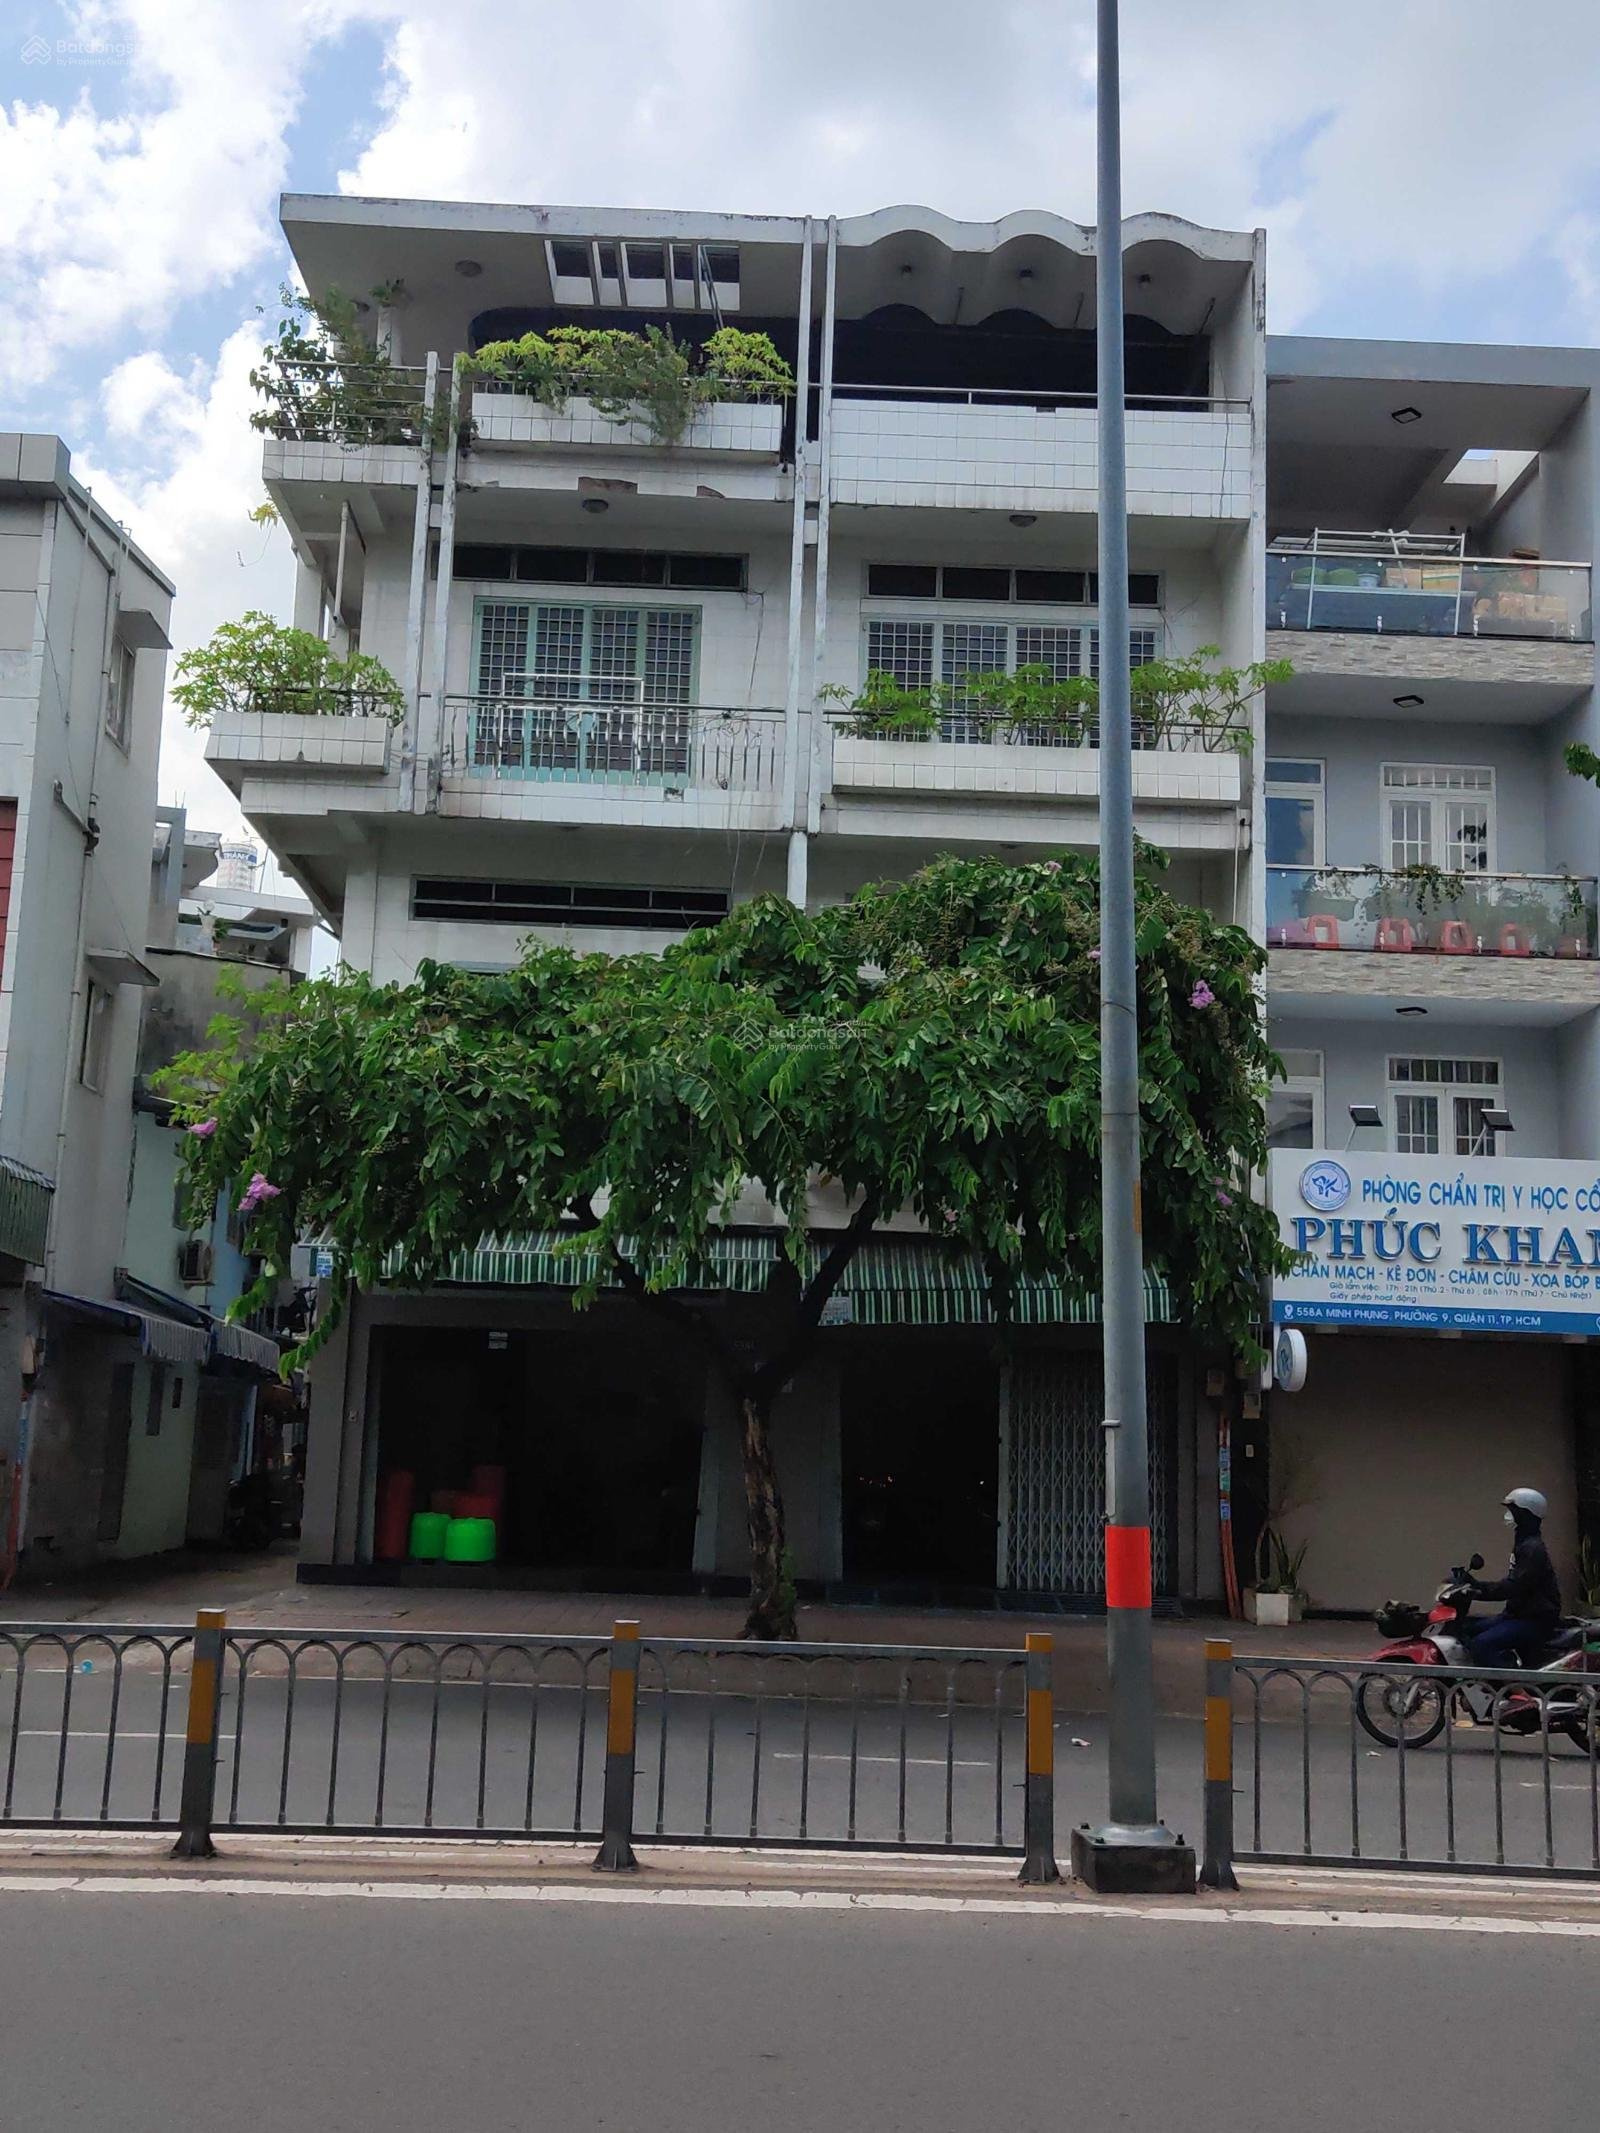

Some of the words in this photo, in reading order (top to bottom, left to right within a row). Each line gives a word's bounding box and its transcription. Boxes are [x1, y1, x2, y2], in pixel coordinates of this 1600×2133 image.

[1363, 1174, 1421, 1205] PHÒNG
[1429, 1172, 1477, 1206] CHẨN
[1484, 1184, 1506, 1212] TRỊ
[1513, 1186, 1523, 1208] Y
[1531, 1187, 1568, 1214] HỌC
[1290, 1207, 1442, 1263] PHÚC
[1387, 1264, 1401, 1281] KÊ
[1407, 1268, 1436, 1283] ĐƠN
[1493, 1267, 1520, 1286] CỨU
[1531, 1273, 1560, 1288] XOA
[1565, 1270, 1590, 1289] BÓP
[1296, 1307, 1323, 1317] 558A
[1326, 1309, 1351, 1318] MINH
[1394, 1308, 1439, 1321] PHƯỜNG
[1454, 1312, 1485, 1325] QUẬN
